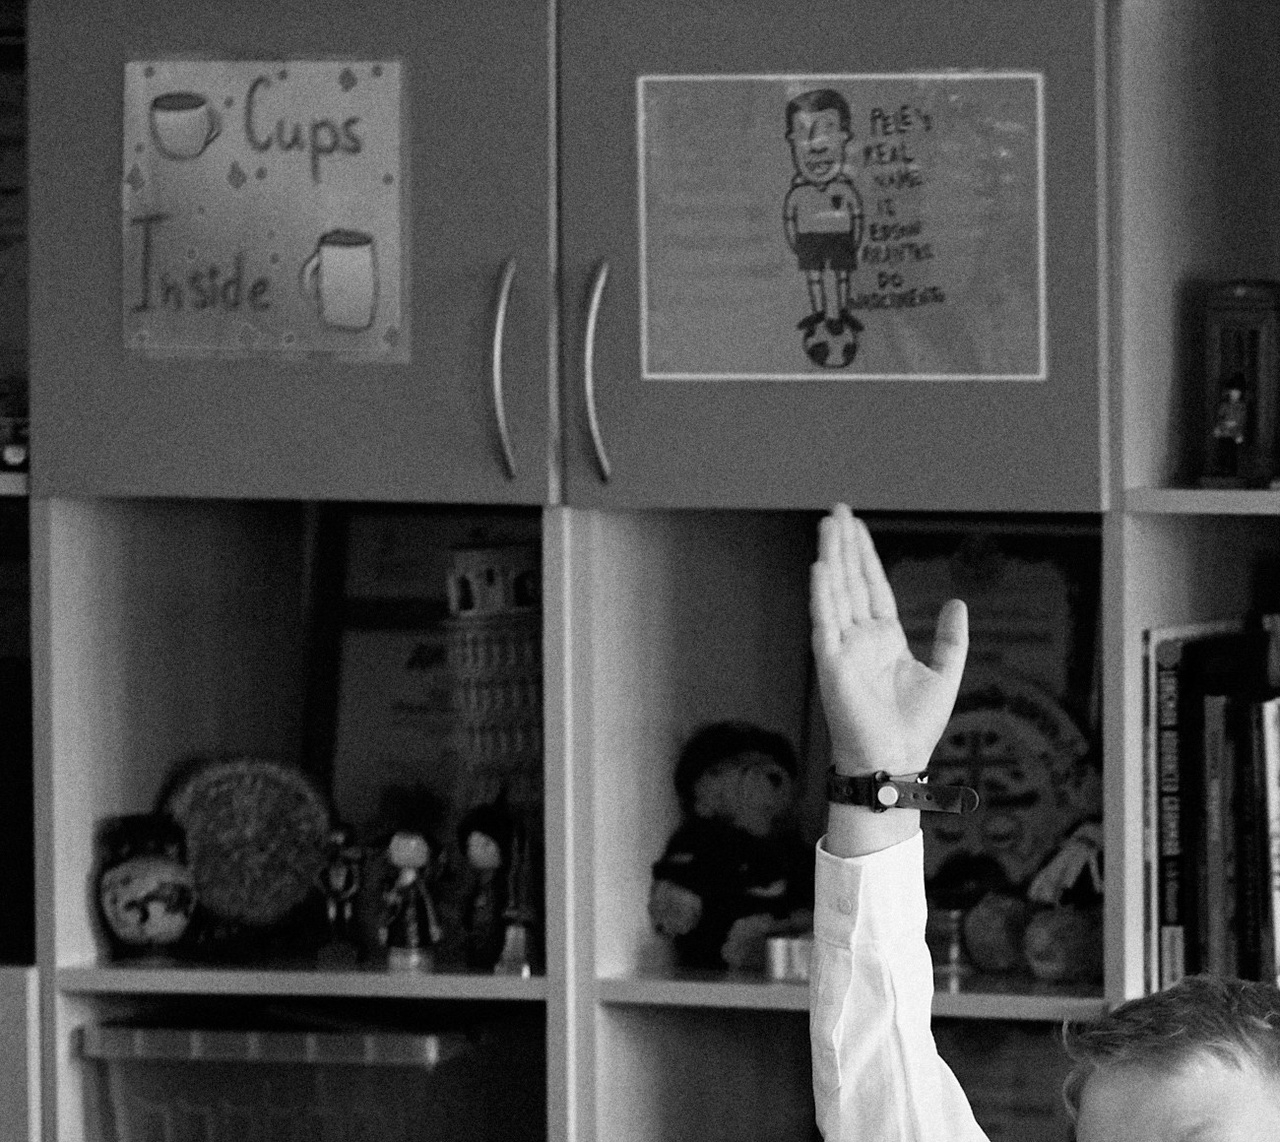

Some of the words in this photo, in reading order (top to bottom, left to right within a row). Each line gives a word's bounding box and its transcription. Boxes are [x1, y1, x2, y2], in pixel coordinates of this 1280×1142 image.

[245, 76, 363, 183] Cups
[131, 213, 272, 313] Inside
[877, 271, 904, 291] DO
